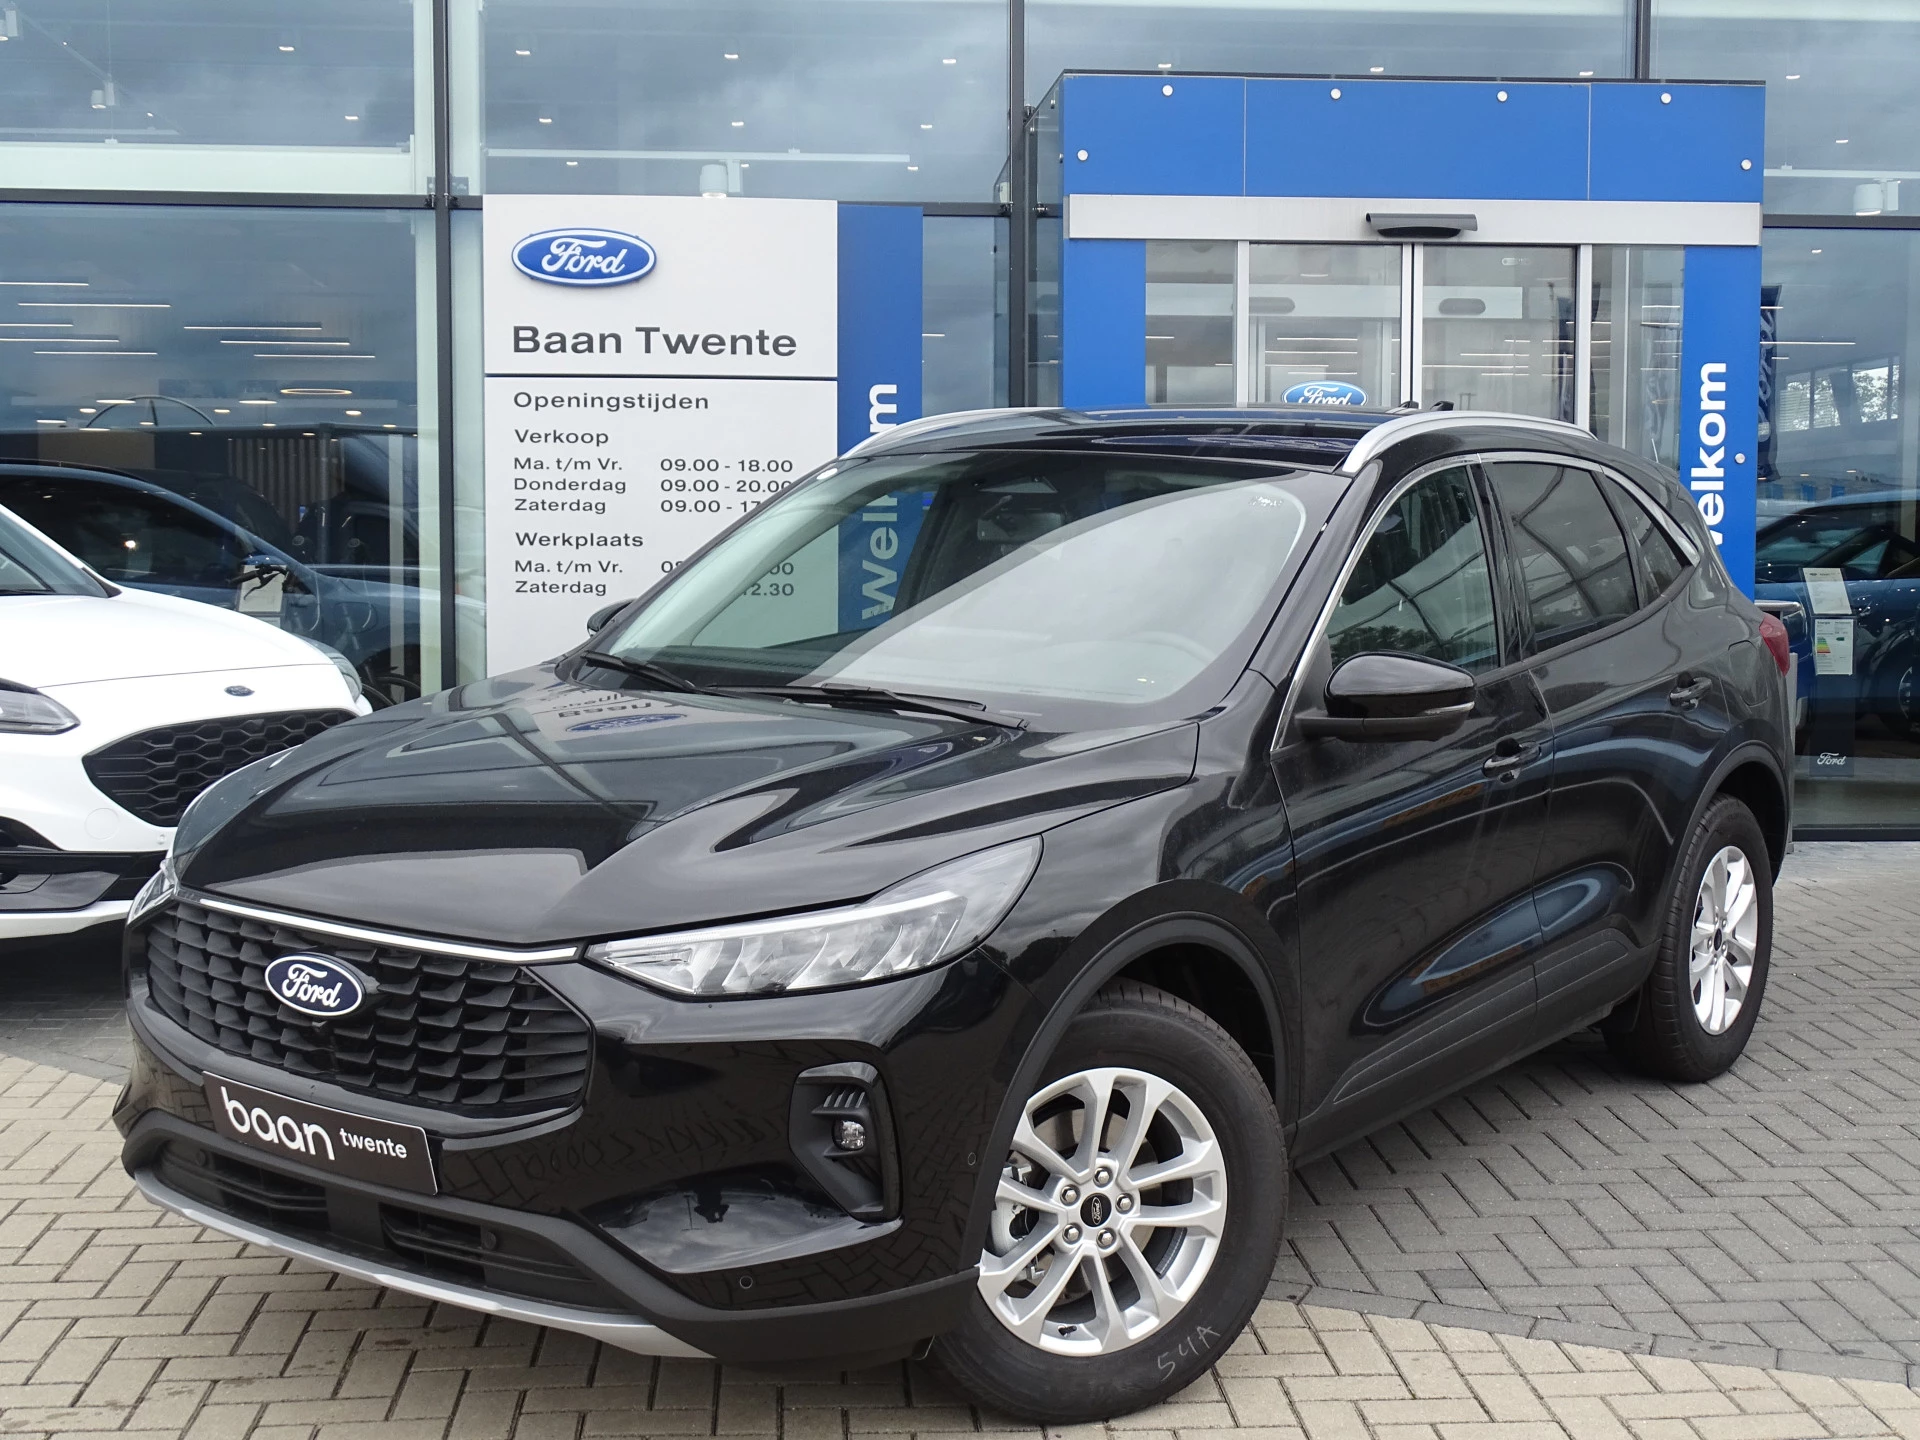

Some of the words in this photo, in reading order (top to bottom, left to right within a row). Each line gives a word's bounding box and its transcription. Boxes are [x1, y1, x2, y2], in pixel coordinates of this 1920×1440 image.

[541, 237, 628, 275] Ford
[513, 325, 622, 355] Baan
[635, 326, 797, 357] Twente
[513, 391, 709, 412] Openingstijden
[514, 429, 609, 446] Verkoop
[513, 457, 550, 471] Ma.
[555, 457, 591, 472] t/m
[597, 457, 623, 471] Vr.
[660, 458, 720, 472] 09.00
[738, 459, 794, 473] 18.00
[514, 477, 627, 495] Donderdag
[660, 479, 720, 492] 09.00
[514, 498, 607, 515] Zaterdag
[660, 500, 721, 513] 09.00
[515, 532, 644, 549] Werkplaats
[514, 559, 551, 573] Ma.
[556, 560, 592, 574] t/m
[597, 560, 623, 574] Vr.
[514, 581, 607, 597] Zaterdag
[1816, 752, 1847, 766] Ford
[281, 963, 343, 1008] Ford
[220, 1086, 336, 1161] baan
[339, 1127, 408, 1159] twente
